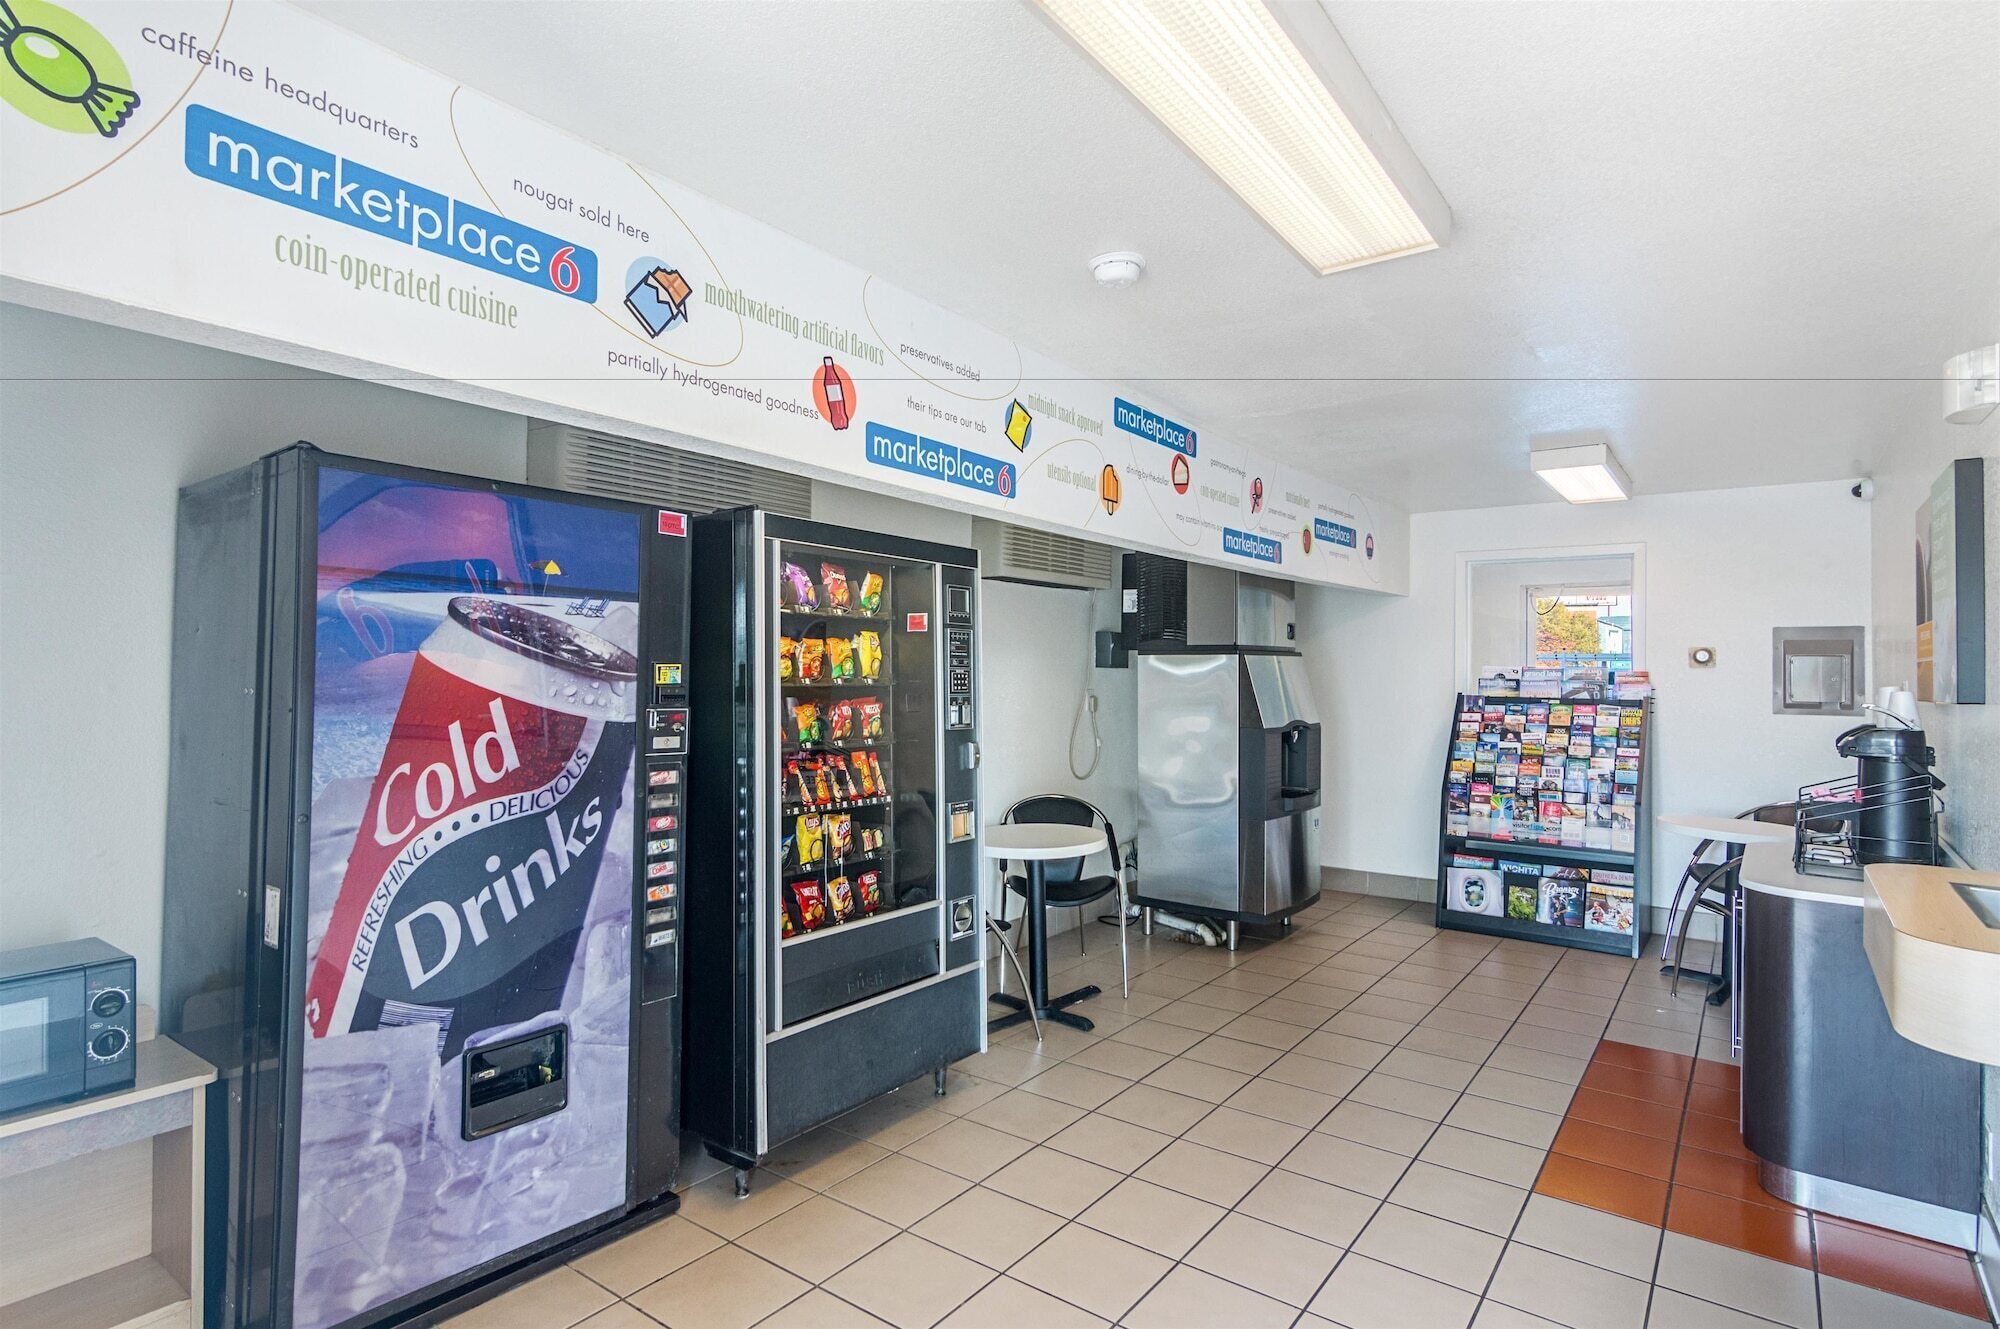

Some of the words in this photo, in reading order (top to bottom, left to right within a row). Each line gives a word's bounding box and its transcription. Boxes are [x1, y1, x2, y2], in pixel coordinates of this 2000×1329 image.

[141, 23, 254, 84] caffeine
[264, 65, 420, 150] headquarters
[206, 125, 542, 274] marketplace
[547, 245, 582, 296] 6
[512, 174, 574, 215] nougat
[579, 199, 611, 229] sold
[616, 211, 651, 244] here
[273, 231, 442, 308] coin-operated
[447, 277, 519, 330] cuisine
[704, 279, 800, 340] mouthwatering
[801, 315, 849, 352] artificial
[850, 331, 885, 367] flavors
[607, 348, 669, 381] partially
[672, 361, 763, 405] hydrogenated
[765, 393, 820, 421] goodness
[899, 340, 954, 372] preservatives
[955, 358, 981, 383] added
[906, 396, 926, 414] their
[927, 404, 942, 422] tips
[943, 411, 959, 425] are
[960, 416, 974, 429] our
[974, 416, 988, 434] tab
[1027, 393, 1058, 419] midnight
[1057, 404, 1077, 423] snack
[1076, 414, 1104, 437] approved
[1117, 406, 1185, 449] marketplace
[1185, 430, 1195, 455] 6
[872, 432, 995, 487] marketplace
[997, 465, 1012, 497] 6
[1046, 462, 1071, 483] utensils
[1072, 469, 1097, 493] optional
[1224, 533, 1274, 562] marketplace
[1315, 520, 1351, 544] marketplace
[373, 696, 521, 846] Cold
[351, 837, 428, 972] REFRESHING
[488, 747, 590, 824] DELICIOUS
[1500, 863, 1539, 876] WICHITA
[394, 796, 603, 991] Drinks
